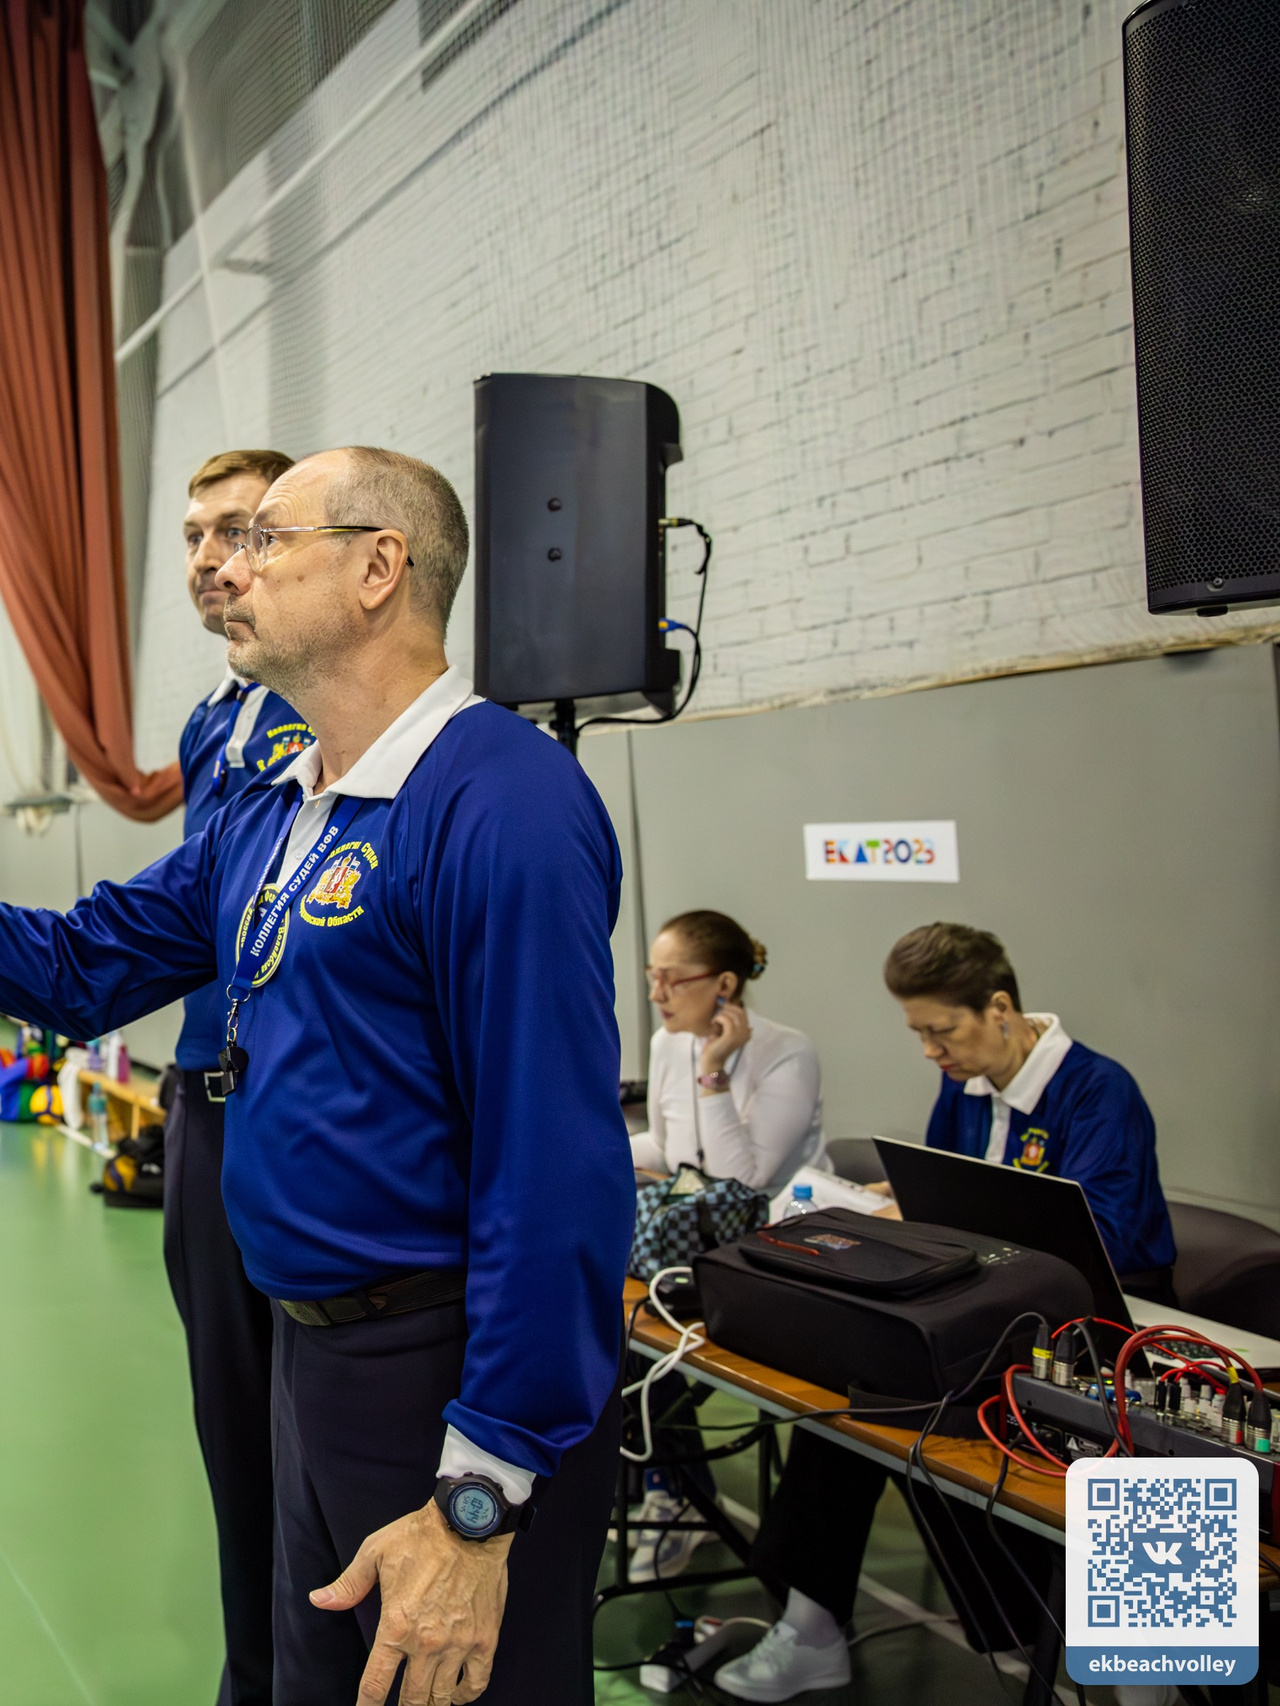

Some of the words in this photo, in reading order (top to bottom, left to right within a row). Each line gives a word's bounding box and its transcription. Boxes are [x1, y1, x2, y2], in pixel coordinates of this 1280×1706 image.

[249, 891, 290, 957] КОЛЛЕГИЯ
[288, 852, 320, 892] СУДЕЙ
[317, 825, 339, 853] ВФВ
